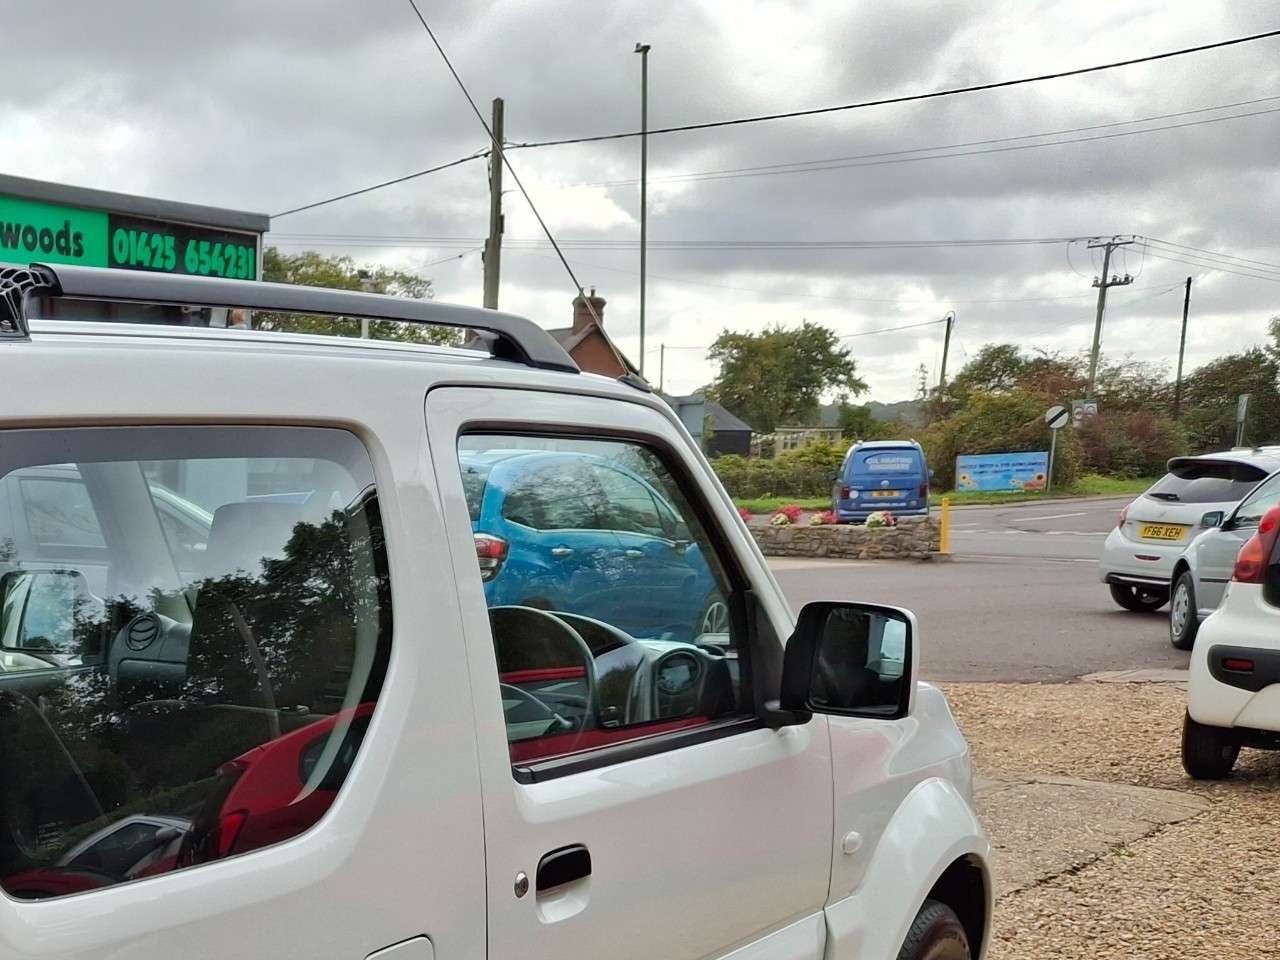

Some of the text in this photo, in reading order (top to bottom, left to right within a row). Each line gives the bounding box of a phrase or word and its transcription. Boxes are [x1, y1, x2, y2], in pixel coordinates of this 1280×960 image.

[113, 228, 256, 280] 01425 654231
[1163, 527, 1182, 538] XEH
